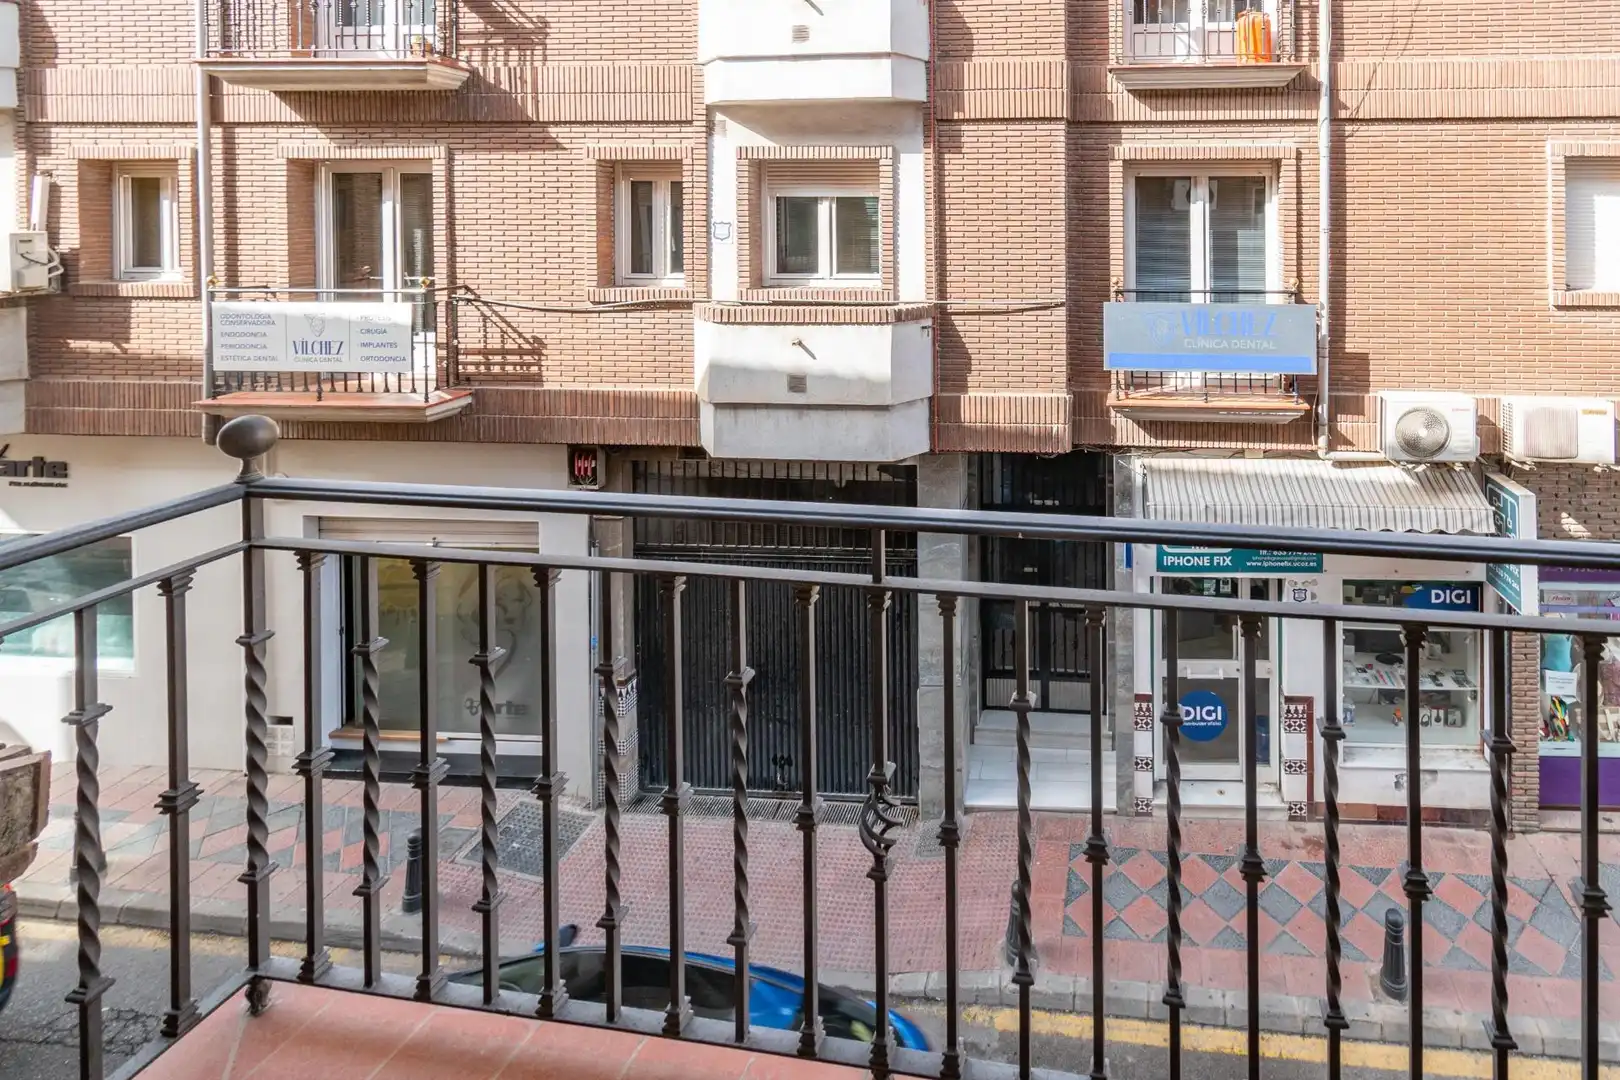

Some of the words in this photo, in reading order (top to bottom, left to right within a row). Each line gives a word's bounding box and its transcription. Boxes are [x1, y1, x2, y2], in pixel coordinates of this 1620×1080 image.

[360, 341, 398, 349] IMPLANTES
[1184, 337, 1229, 349] CLÍNICA
[1231, 340, 1277, 350] DENTAL
[360, 355, 407, 363] ORTODONCIA
[1163, 555, 1211, 567] IPHONE
[1213, 556, 1233, 567] FIX
[1431, 589, 1471, 604] DIGI
[1181, 705, 1222, 721] DIGI
